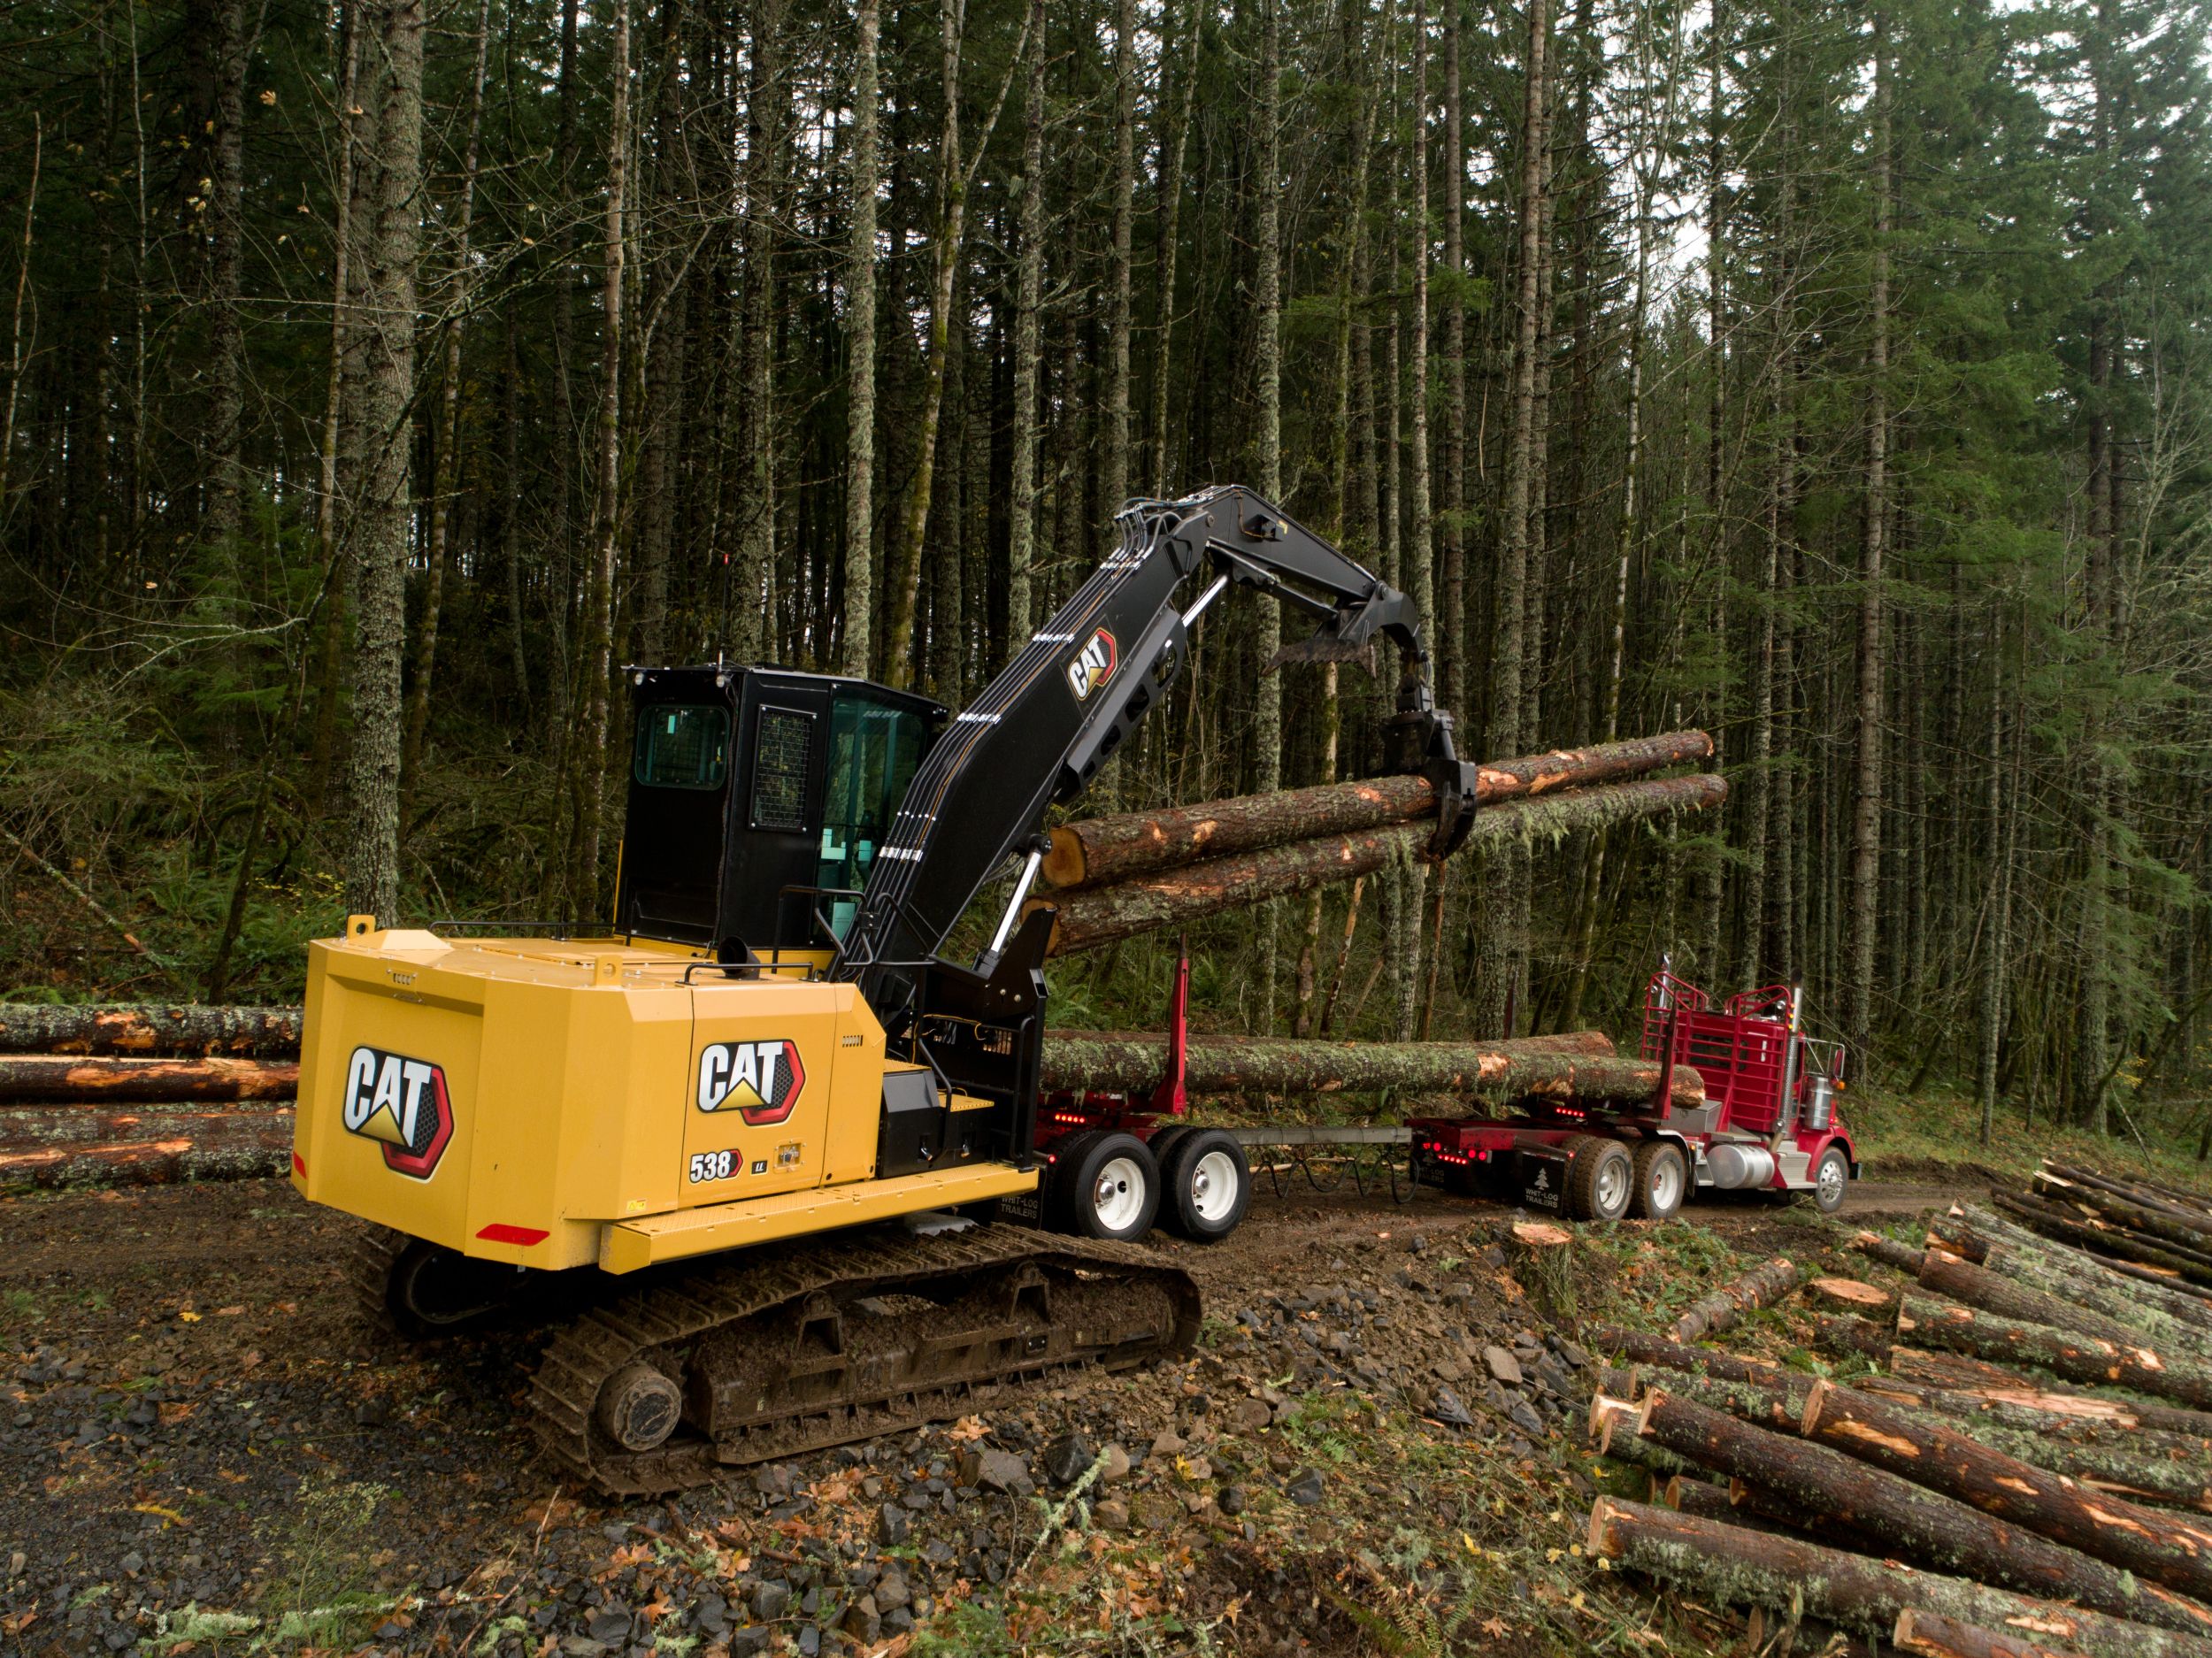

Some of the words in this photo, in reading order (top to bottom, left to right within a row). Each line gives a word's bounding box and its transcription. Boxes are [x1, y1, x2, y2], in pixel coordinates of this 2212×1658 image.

[1069, 634, 1107, 697] CAT
[699, 1042, 783, 1111] CAT
[344, 1048, 432, 1148] CAT
[690, 1151, 731, 1182] 538
[1525, 1187, 1558, 1201] WHIT-LOG
[1525, 1194, 1558, 1209] TRAILERS
[1001, 1203, 1038, 1219] TRAILERS
